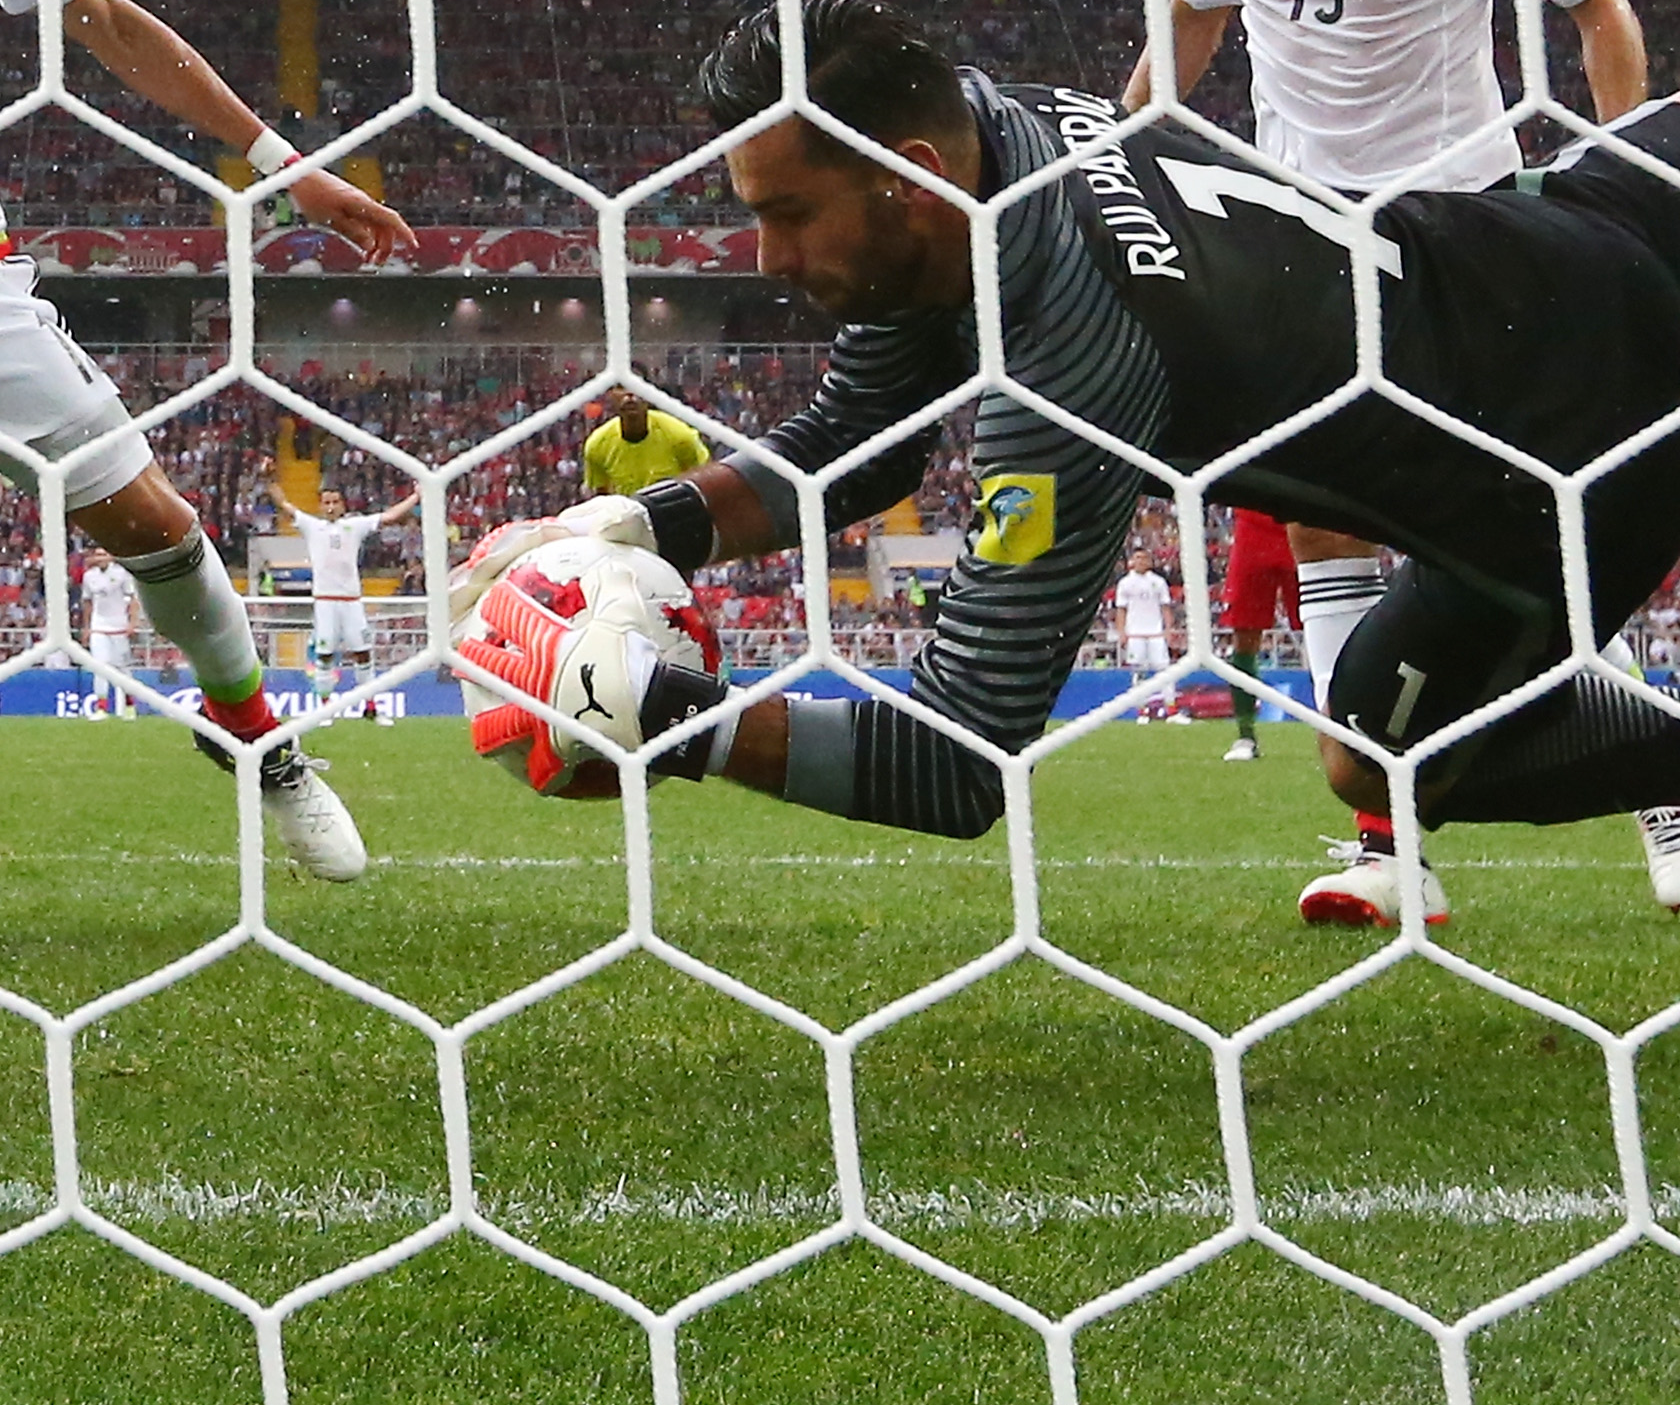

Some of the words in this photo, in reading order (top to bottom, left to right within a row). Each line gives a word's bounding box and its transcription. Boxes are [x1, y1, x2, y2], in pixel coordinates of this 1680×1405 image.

[1101, 205, 1187, 281] RUI
[1156, 155, 1403, 280] 1
[263, 691, 407, 718] YUDAI
[1385, 661, 1427, 740] 1
